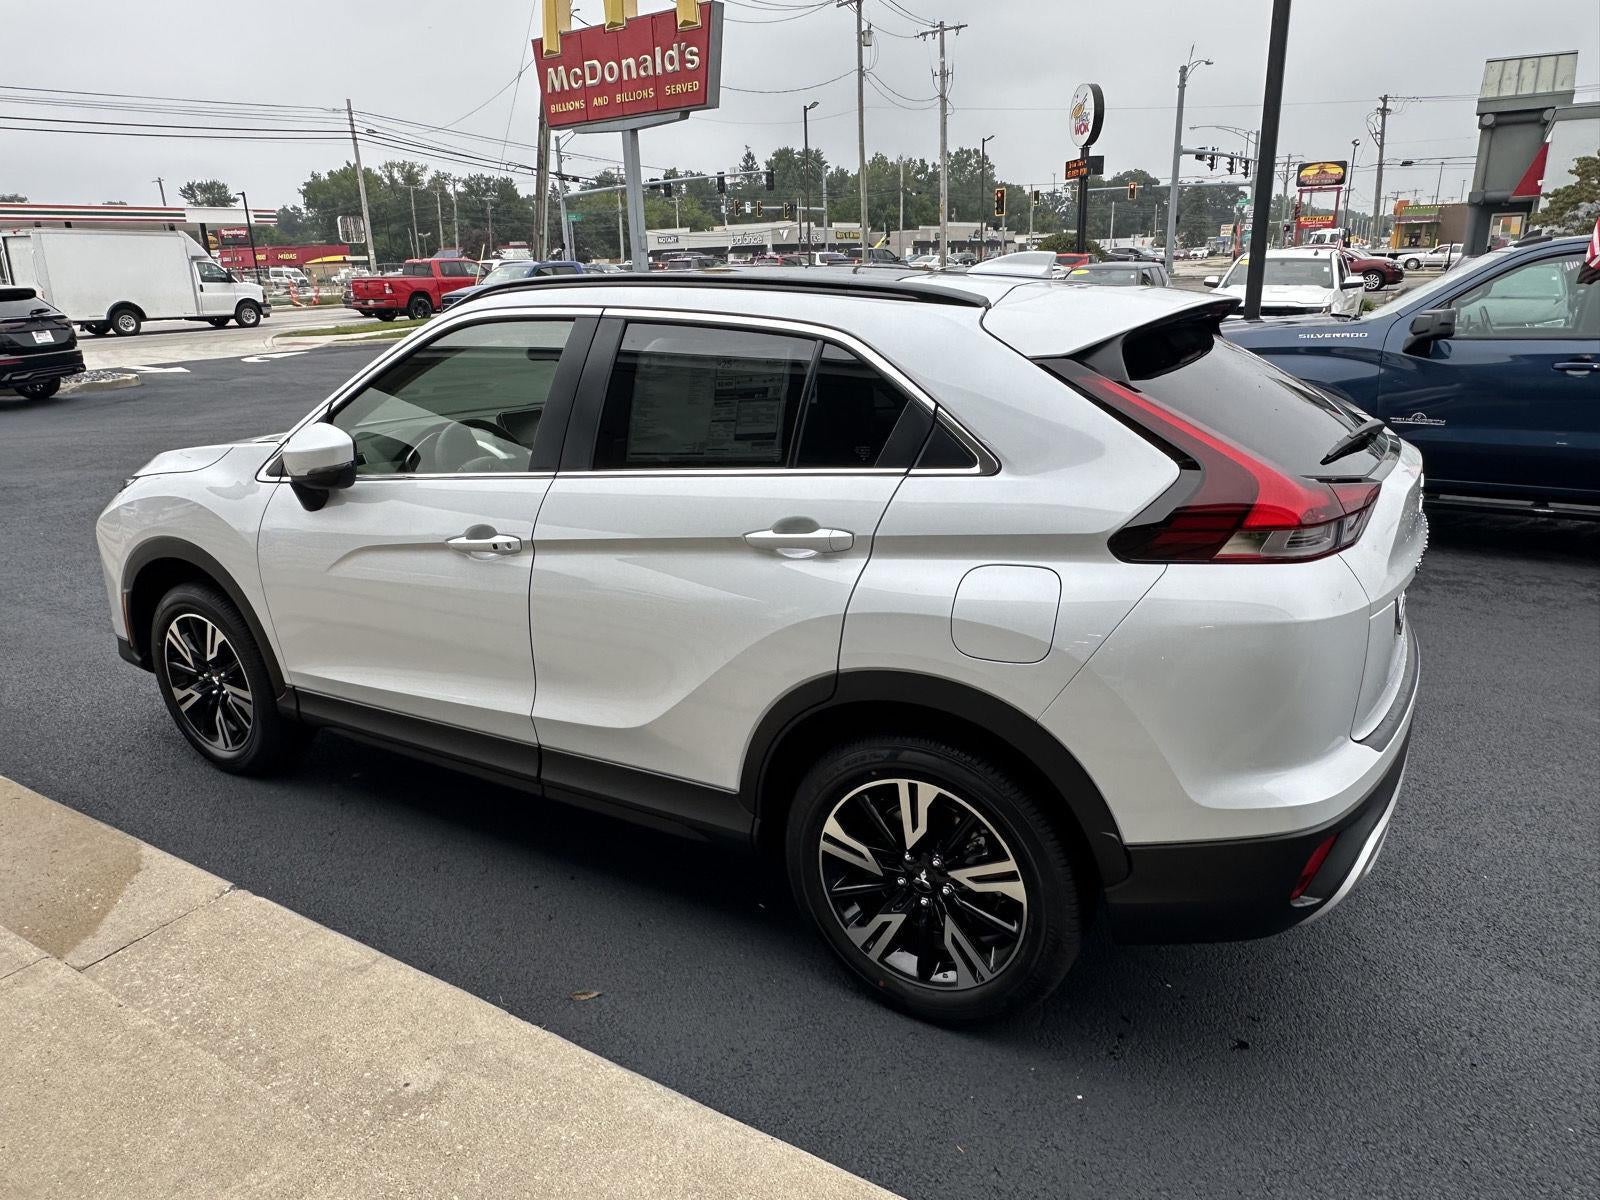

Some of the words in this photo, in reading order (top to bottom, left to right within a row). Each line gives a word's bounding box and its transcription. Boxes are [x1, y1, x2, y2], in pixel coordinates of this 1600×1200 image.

[547, 42, 700, 94] McDonald's
[550, 99, 586, 114] BILLIONS
[592, 95, 609, 108] AND
[615, 87, 655, 104] BILLIONS
[665, 80, 700, 96] SERVED
[221, 228, 247, 236] Speedway
